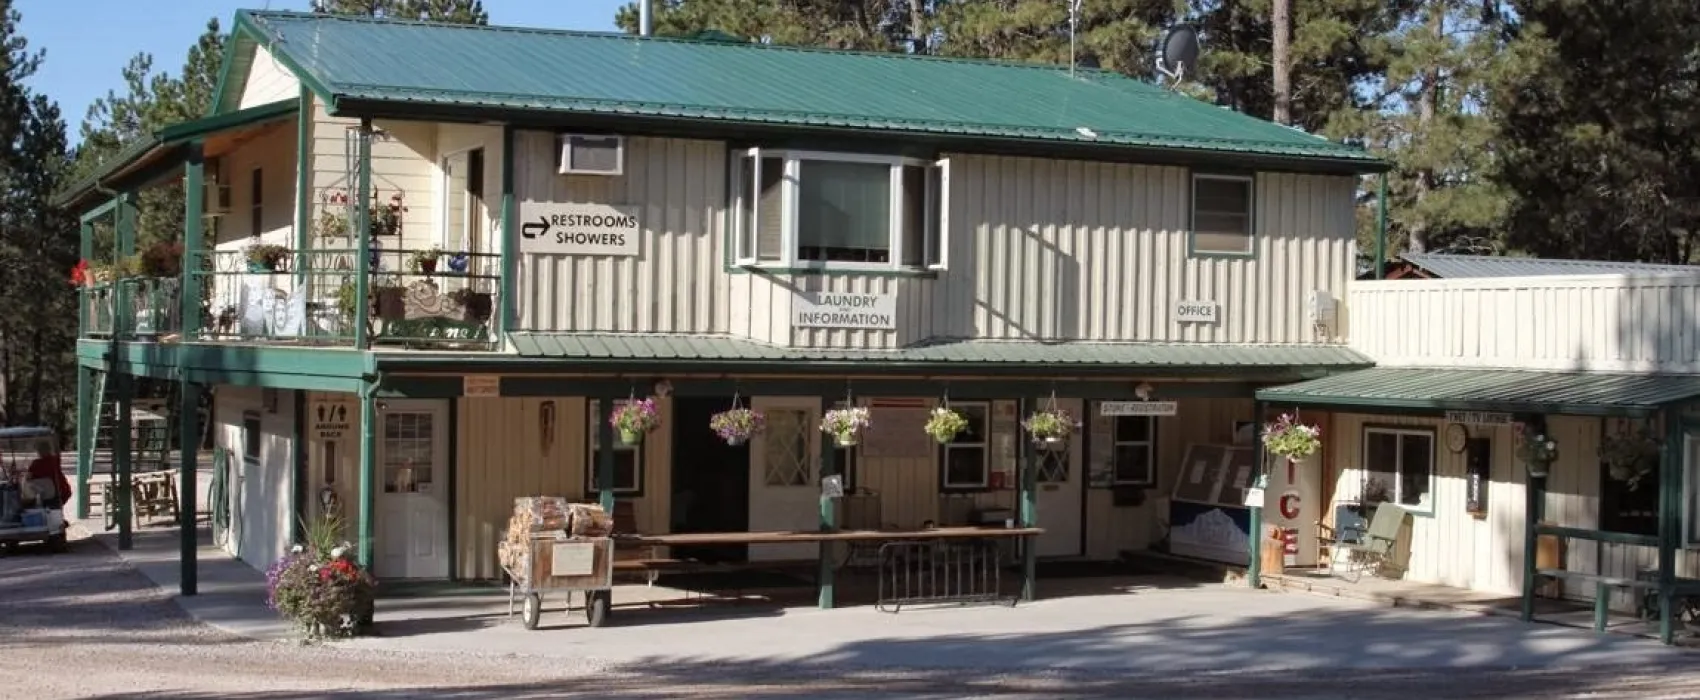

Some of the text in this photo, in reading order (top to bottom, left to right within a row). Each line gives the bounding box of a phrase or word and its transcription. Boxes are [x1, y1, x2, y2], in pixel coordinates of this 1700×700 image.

[551, 214, 637, 229] RESTROOMS
[556, 231, 626, 246] SHOWERS
[818, 295, 877, 307] LAUNDRY
[1178, 304, 1213, 316] OFFICE
[799, 311, 891, 325] INFORMATION
[1280, 459, 1301, 555] ICE
